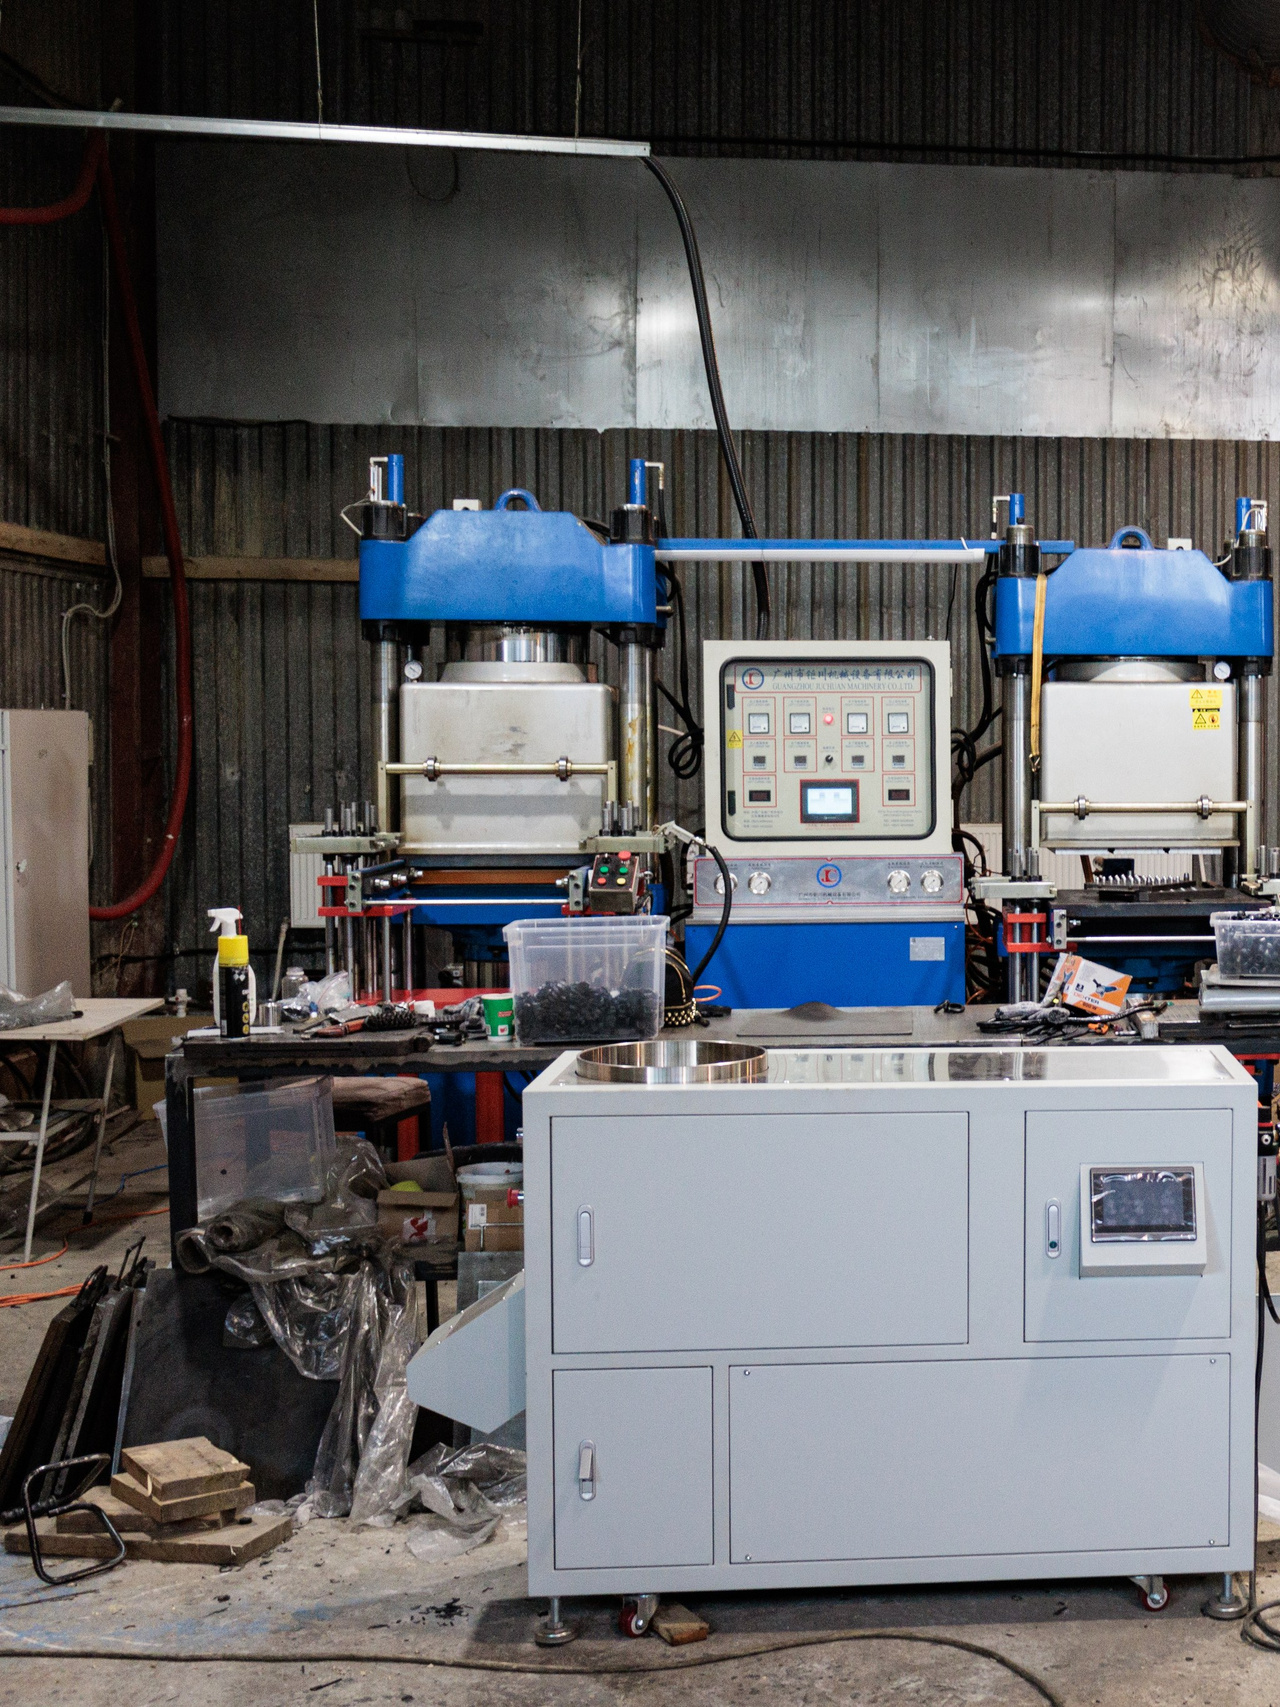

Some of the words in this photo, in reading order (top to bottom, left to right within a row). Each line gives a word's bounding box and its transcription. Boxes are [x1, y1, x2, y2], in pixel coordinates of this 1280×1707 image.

[772, 682, 814, 691] GUANGZHOU
[815, 682, 846, 691] JUCHUAN
[847, 682, 886, 691] MACHINERY
